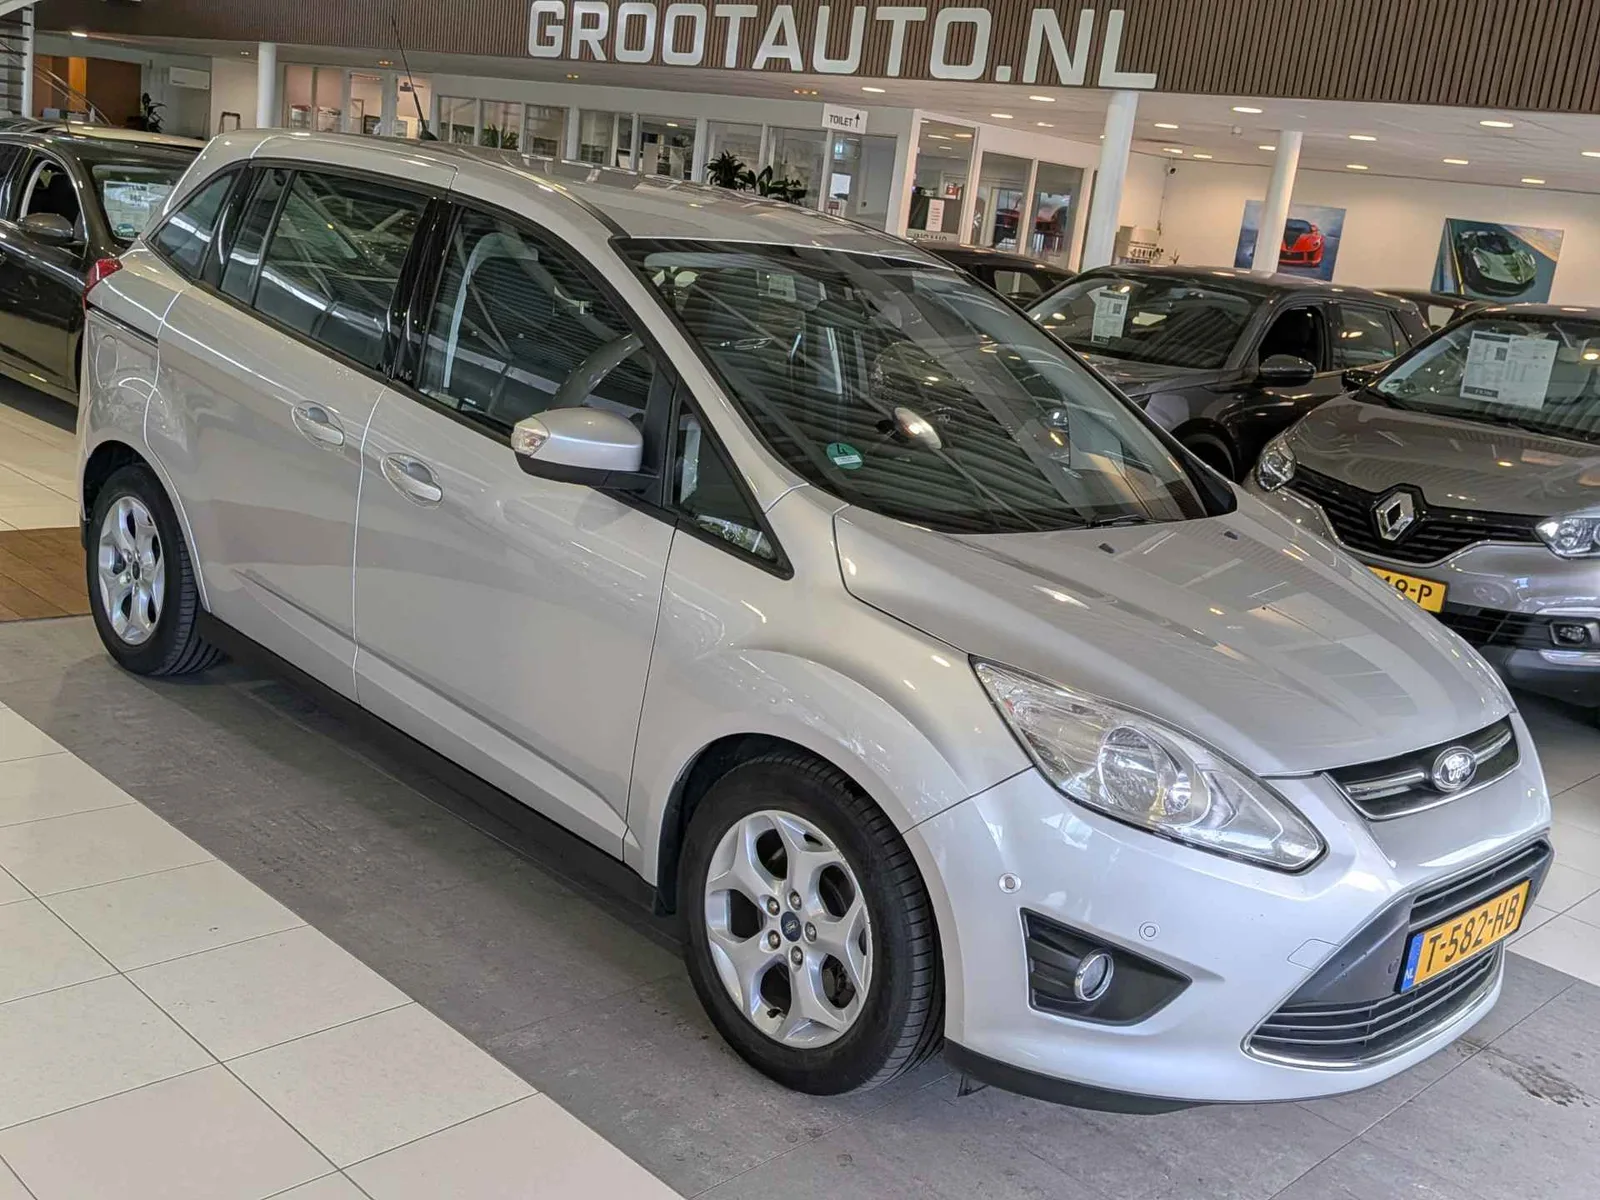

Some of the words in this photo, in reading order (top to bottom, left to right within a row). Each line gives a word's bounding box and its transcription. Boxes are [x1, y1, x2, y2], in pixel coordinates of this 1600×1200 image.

[528, 0, 1157, 89] GROOTAUTO.NL
[829, 114, 853, 127] TOILET
[1426, 893, 1520, 973] T-582-HB
[1404, 966, 1414, 980] NL
